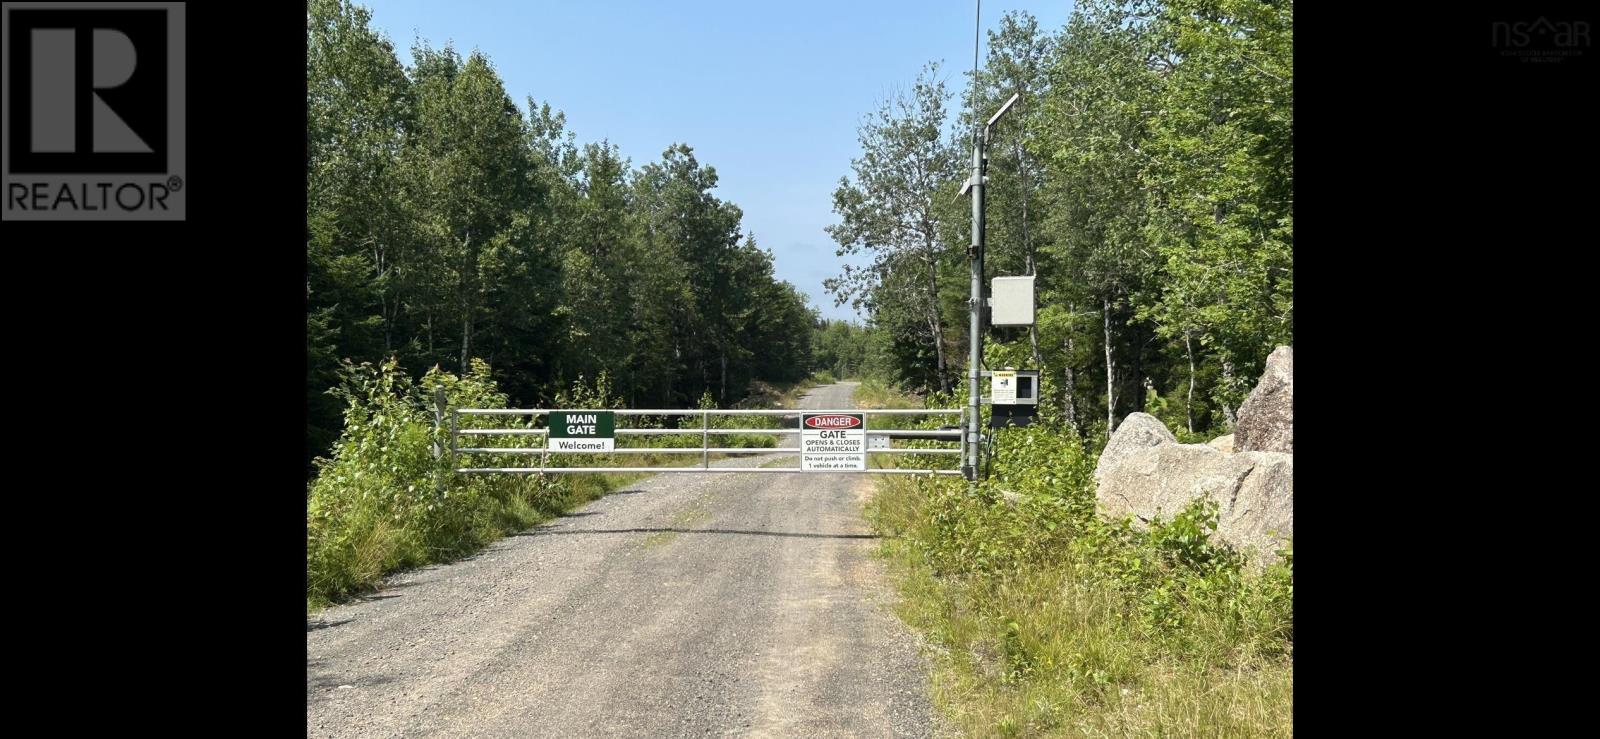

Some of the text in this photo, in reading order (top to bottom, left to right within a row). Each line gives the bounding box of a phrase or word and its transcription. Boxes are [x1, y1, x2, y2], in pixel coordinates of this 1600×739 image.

[566, 414, 597, 424] MAIN
[815, 417, 852, 426] DANGER
[566, 425, 596, 435] GATE
[820, 430, 846, 439] GATE
[559, 441, 605, 450] Welcome!
